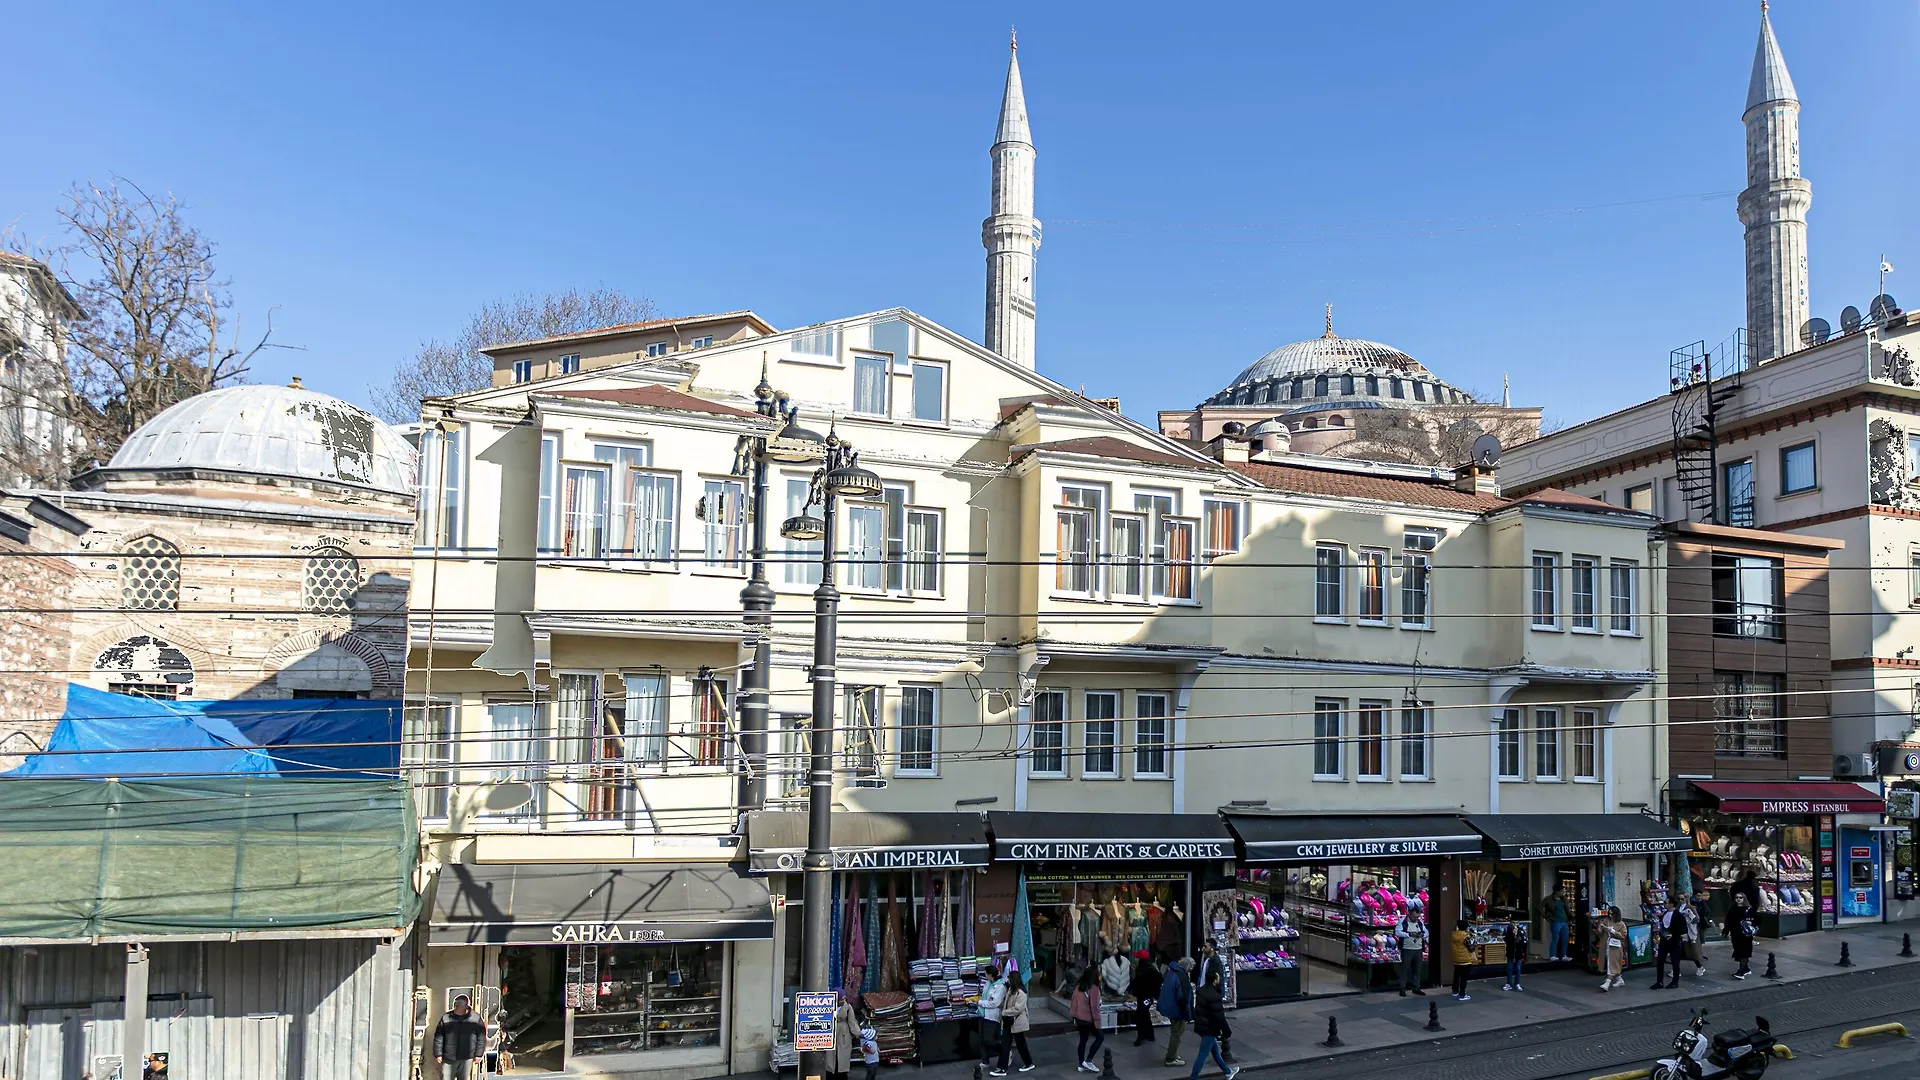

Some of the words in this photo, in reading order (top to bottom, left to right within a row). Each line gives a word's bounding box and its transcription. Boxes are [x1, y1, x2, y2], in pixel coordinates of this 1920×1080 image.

[1762, 801, 1809, 813] EMPRESS
[1813, 803, 1850, 812] ISTANBUL
[1011, 844, 1050, 859] CKM
[1055, 844, 1090, 859] FINE
[1093, 843, 1133, 858] ARTS
[1139, 845, 1152, 858] &
[1156, 843, 1222, 858] CARPETS
[1297, 845, 1323, 857] CKM
[1326, 843, 1385, 857] JEWELLERY
[1389, 843, 1399, 853] &
[1401, 841, 1438, 852] SILVER
[1519, 845, 1551, 858] ŞÖHRET
[1553, 843, 1598, 855] KURUYEMİŞ
[1600, 843, 1633, 852] TURKISH
[1634, 842, 1647, 851] ICE
[1648, 841, 1676, 850] CREAM
[777, 852, 878, 870] OTMAN
[884, 850, 964, 867] IMPERIAL
[978, 913, 1013, 924] CKM
[552, 924, 624, 942] SAHRA
[799, 996, 834, 1006] DİKKAT
